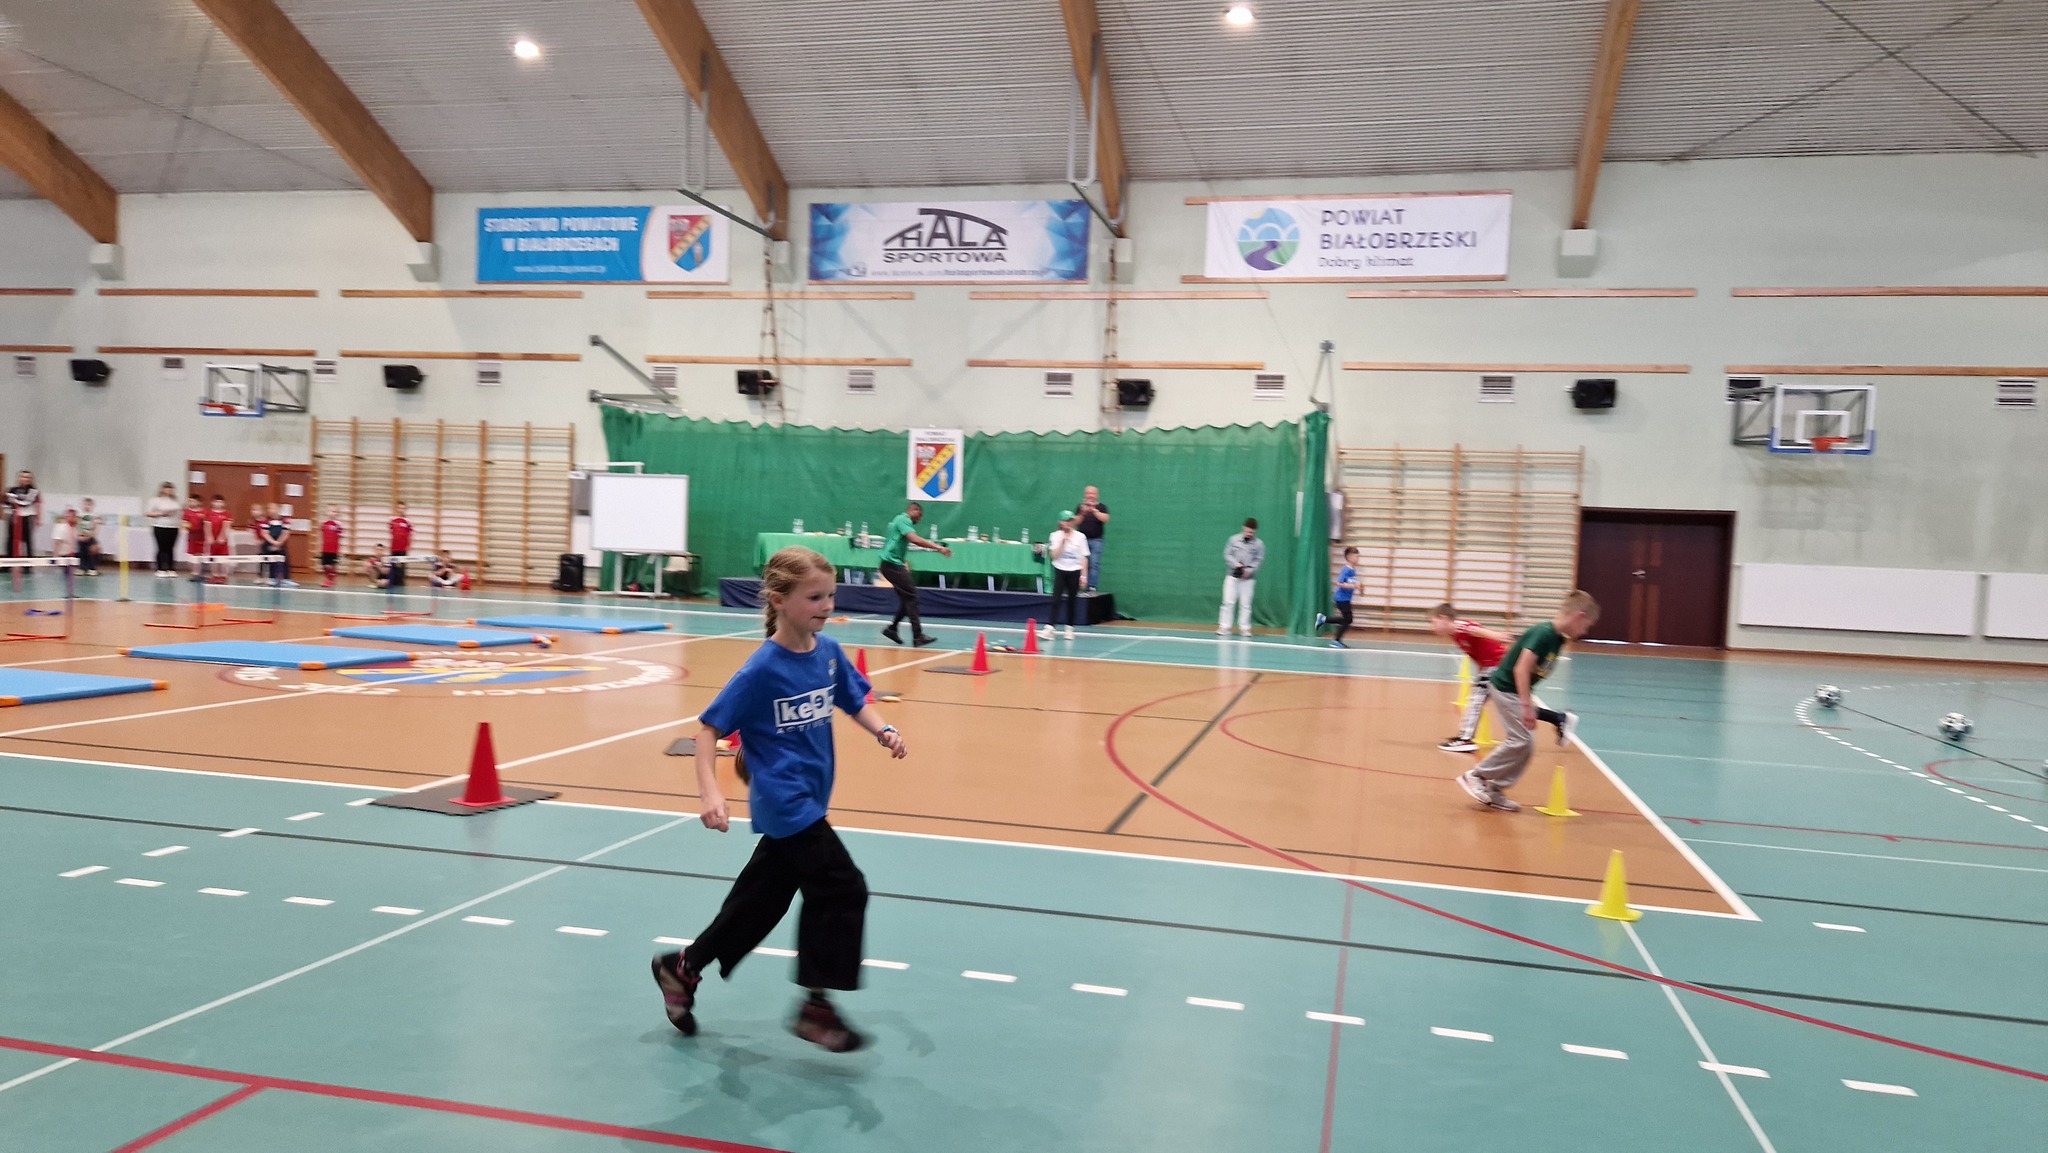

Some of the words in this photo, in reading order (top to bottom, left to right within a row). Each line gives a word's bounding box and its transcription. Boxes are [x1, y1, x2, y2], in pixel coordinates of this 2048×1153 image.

[1320, 207, 1405, 226] POWIAT
[901, 210, 1008, 247] HALA
[1320, 231, 1478, 250] BIAŁOBRZESKI
[883, 251, 1007, 264] SPORTOWA
[1318, 256, 1361, 269] Dobry
